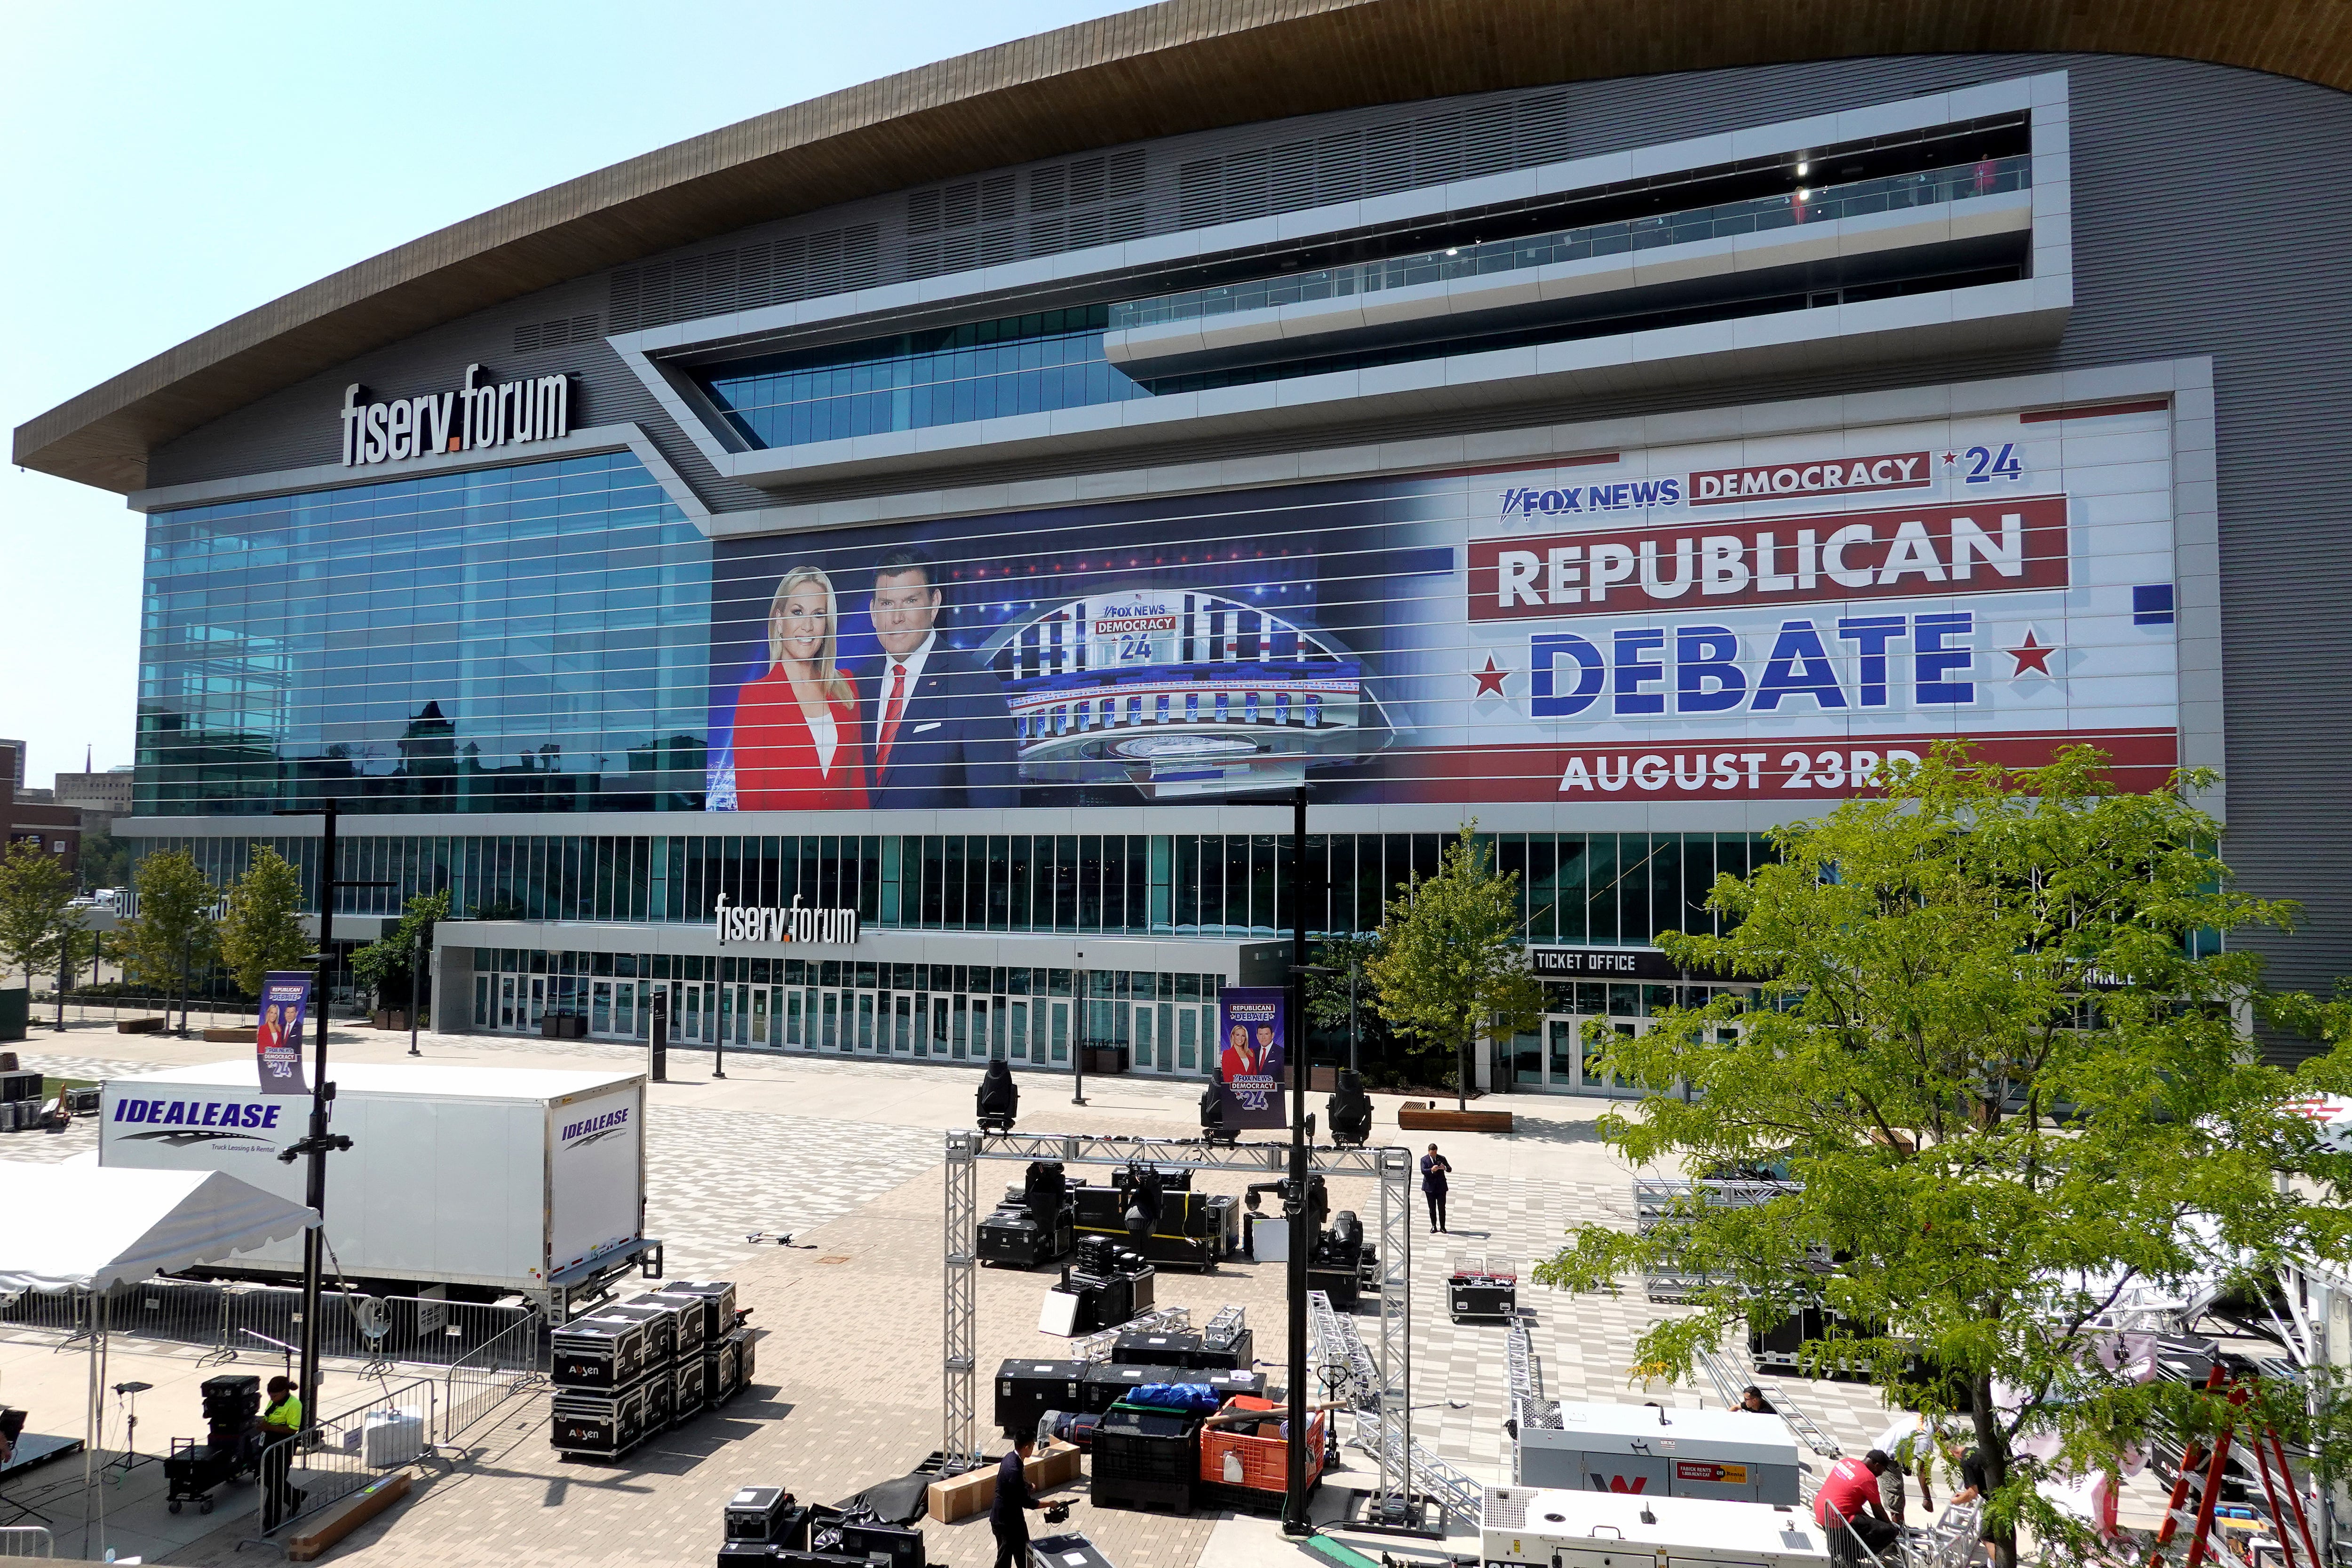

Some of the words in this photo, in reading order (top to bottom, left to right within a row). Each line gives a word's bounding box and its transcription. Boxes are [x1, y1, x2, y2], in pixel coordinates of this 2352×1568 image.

[1524, 486, 1581, 517] FOX
[1588, 478, 1680, 509] NEWS
[1700, 456, 1919, 500] DEMOCRACY
[1964, 443, 2023, 485] 24
[1498, 513, 2022, 607] REPUBLICAN
[1112, 606, 1132, 618] FOX
[1134, 604, 1166, 616] NEWS
[1098, 618, 1173, 633] DEMOCRACY
[1120, 633, 1152, 660] 24
[1529, 610, 1976, 719] DEBATE
[1558, 753, 1766, 792] AUGUST
[1536, 953, 1582, 969] TICKET
[1589, 954, 1636, 971] OFFICE
[272, 1061, 290, 1075] 24
[1242, 1090, 1266, 1107] 24
[114, 1099, 282, 1128] IDEALEASE
[562, 1108, 629, 1141] IDEALEASE
